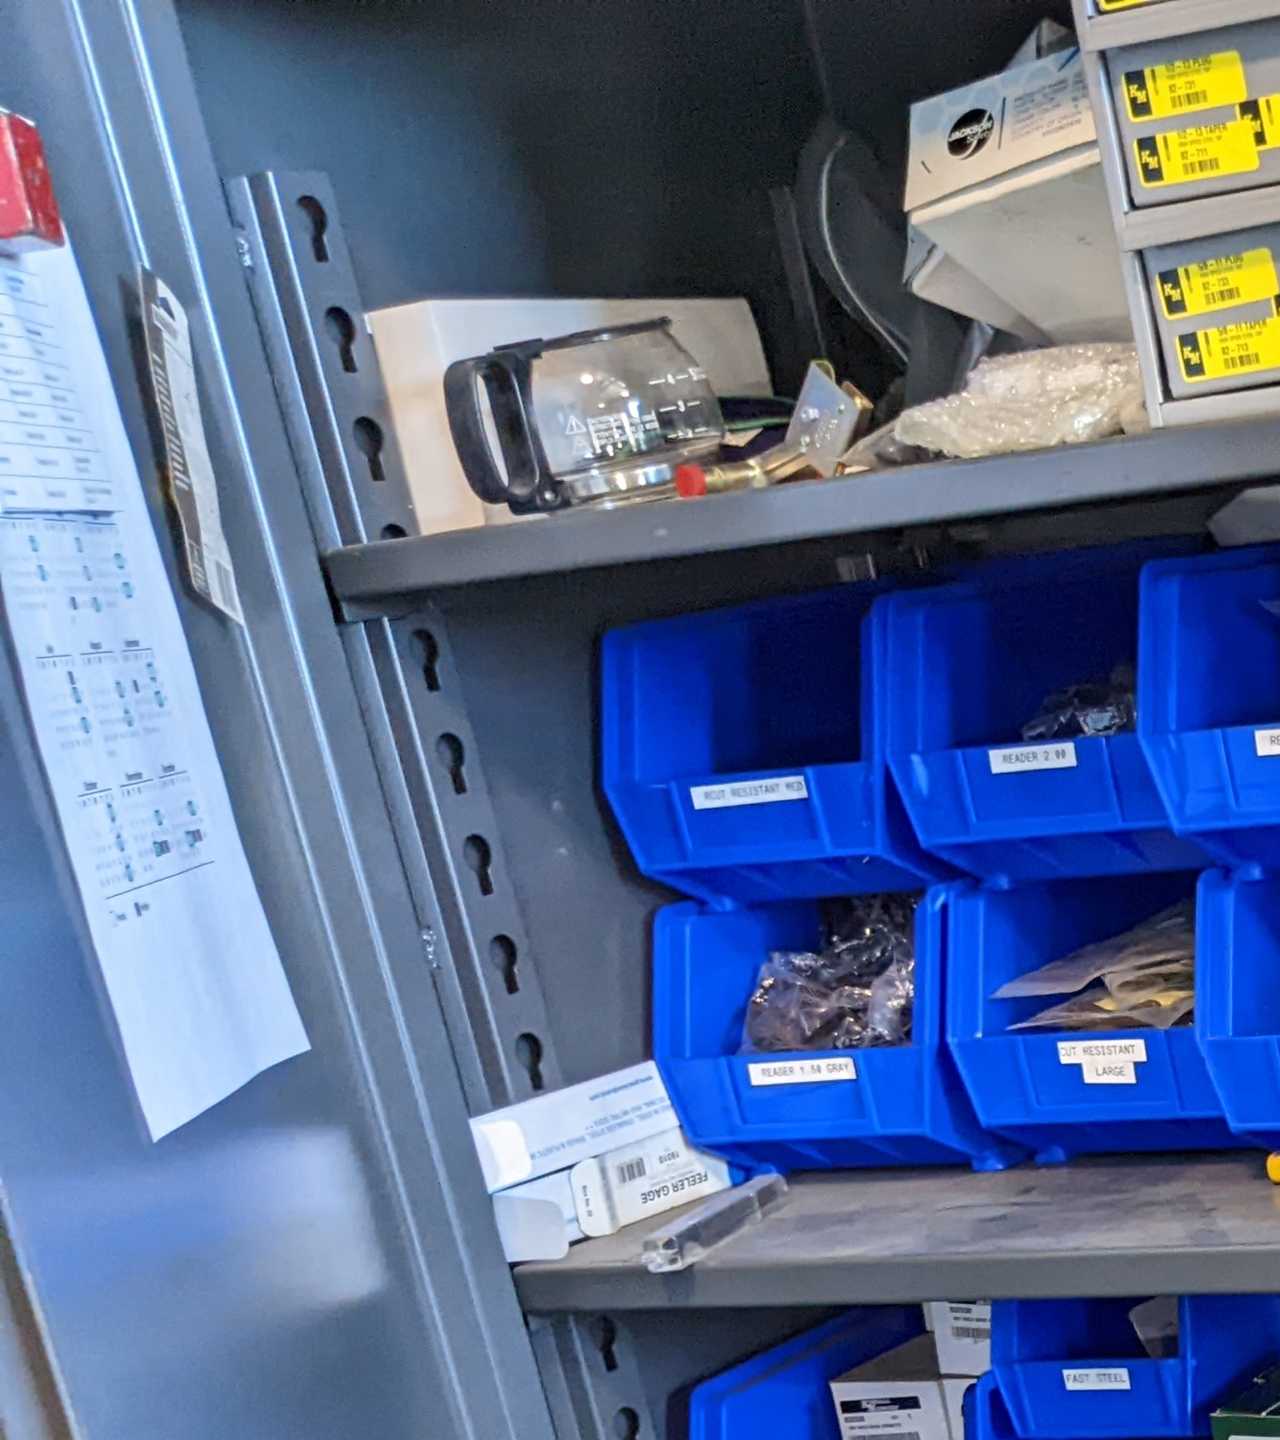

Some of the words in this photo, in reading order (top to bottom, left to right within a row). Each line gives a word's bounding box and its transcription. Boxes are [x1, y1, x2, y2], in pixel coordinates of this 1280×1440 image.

[1002, 751, 1038, 764] READER
[1083, 1045, 1135, 1056] RESISTANT
[1095, 1066, 1126, 1076] LARGE
[673, 1171, 708, 1193] FEELER
[641, 1183, 670, 1204] GAGE
